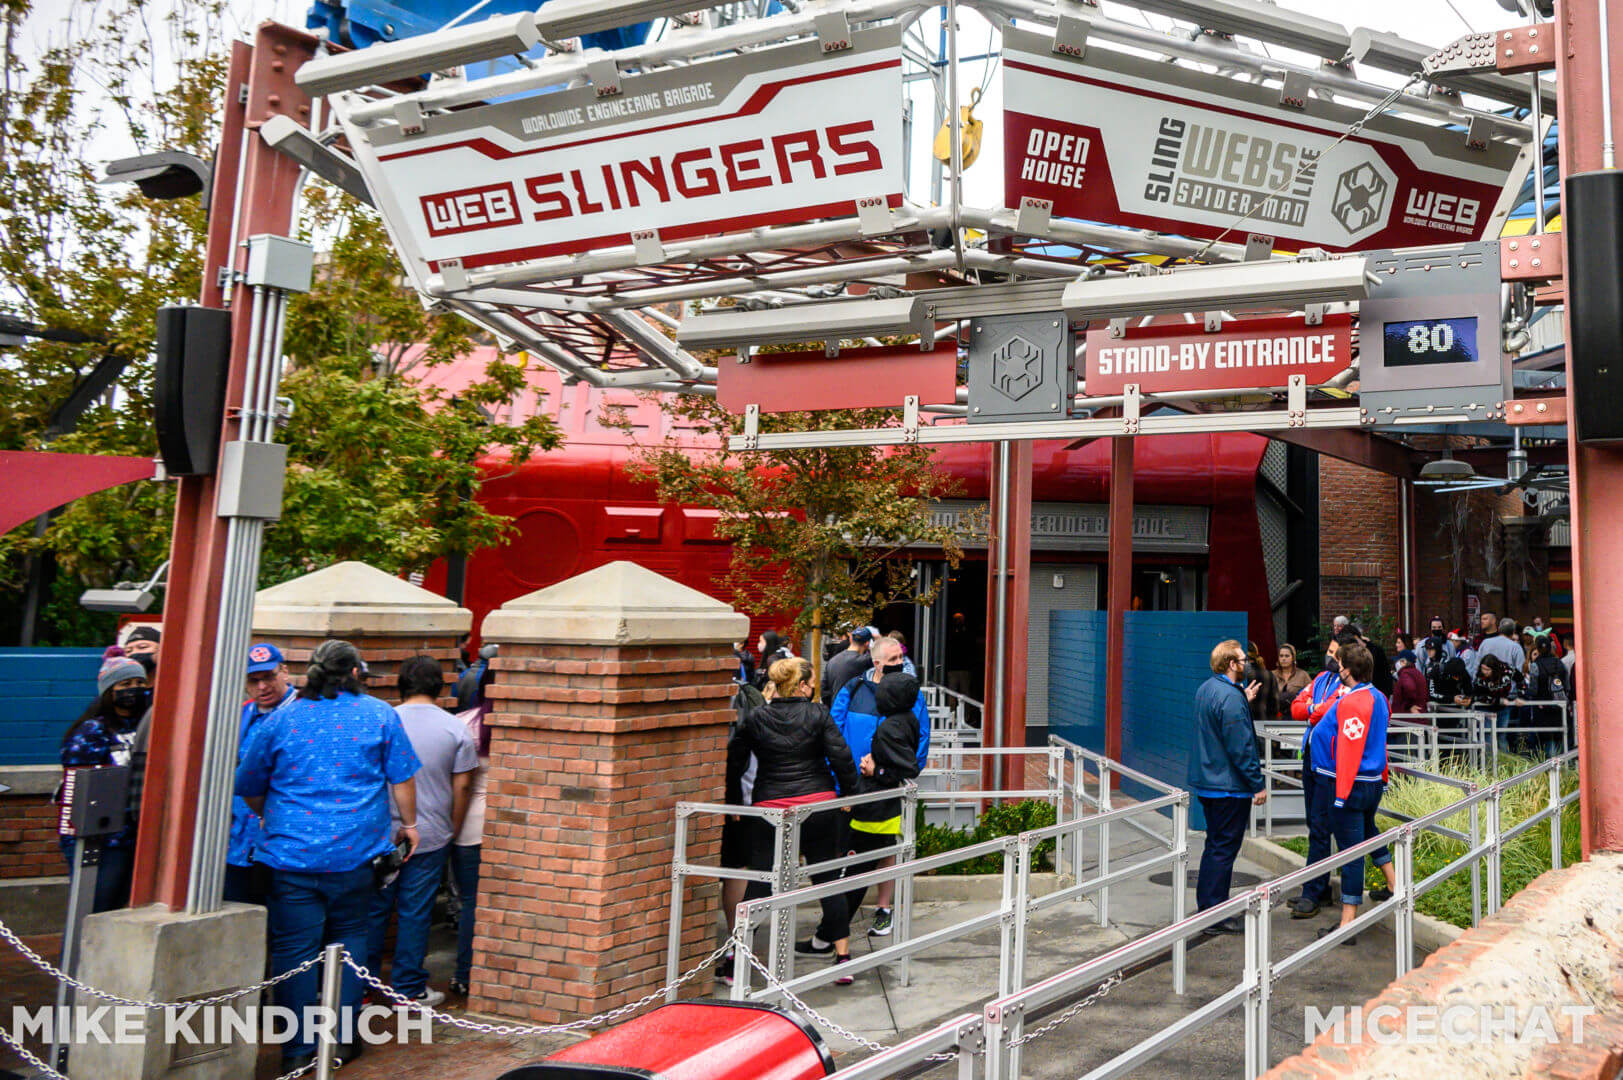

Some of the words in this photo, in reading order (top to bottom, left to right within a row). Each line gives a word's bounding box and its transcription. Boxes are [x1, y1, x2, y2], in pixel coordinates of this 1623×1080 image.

[521, 108, 585, 134] WORLDWIDE
[586, 94, 662, 122] ENGINEERING
[664, 82, 716, 107] BRIGADE
[1027, 128, 1090, 165] OPEN
[1144, 117, 1186, 203] SLING
[1182, 124, 1298, 192] WEBS
[1292, 147, 1321, 198] LIKE
[425, 188, 516, 231] WEB
[525, 120, 883, 222] SLINGERS
[1021, 157, 1086, 189] HOUSE
[1176, 182, 1305, 223] SPIDER-MAN
[1406, 187, 1480, 226] WEB
[1099, 342, 1210, 375] STAND-BY
[1215, 334, 1335, 369] ENTRANCE
[1407, 324, 1454, 353] 80
